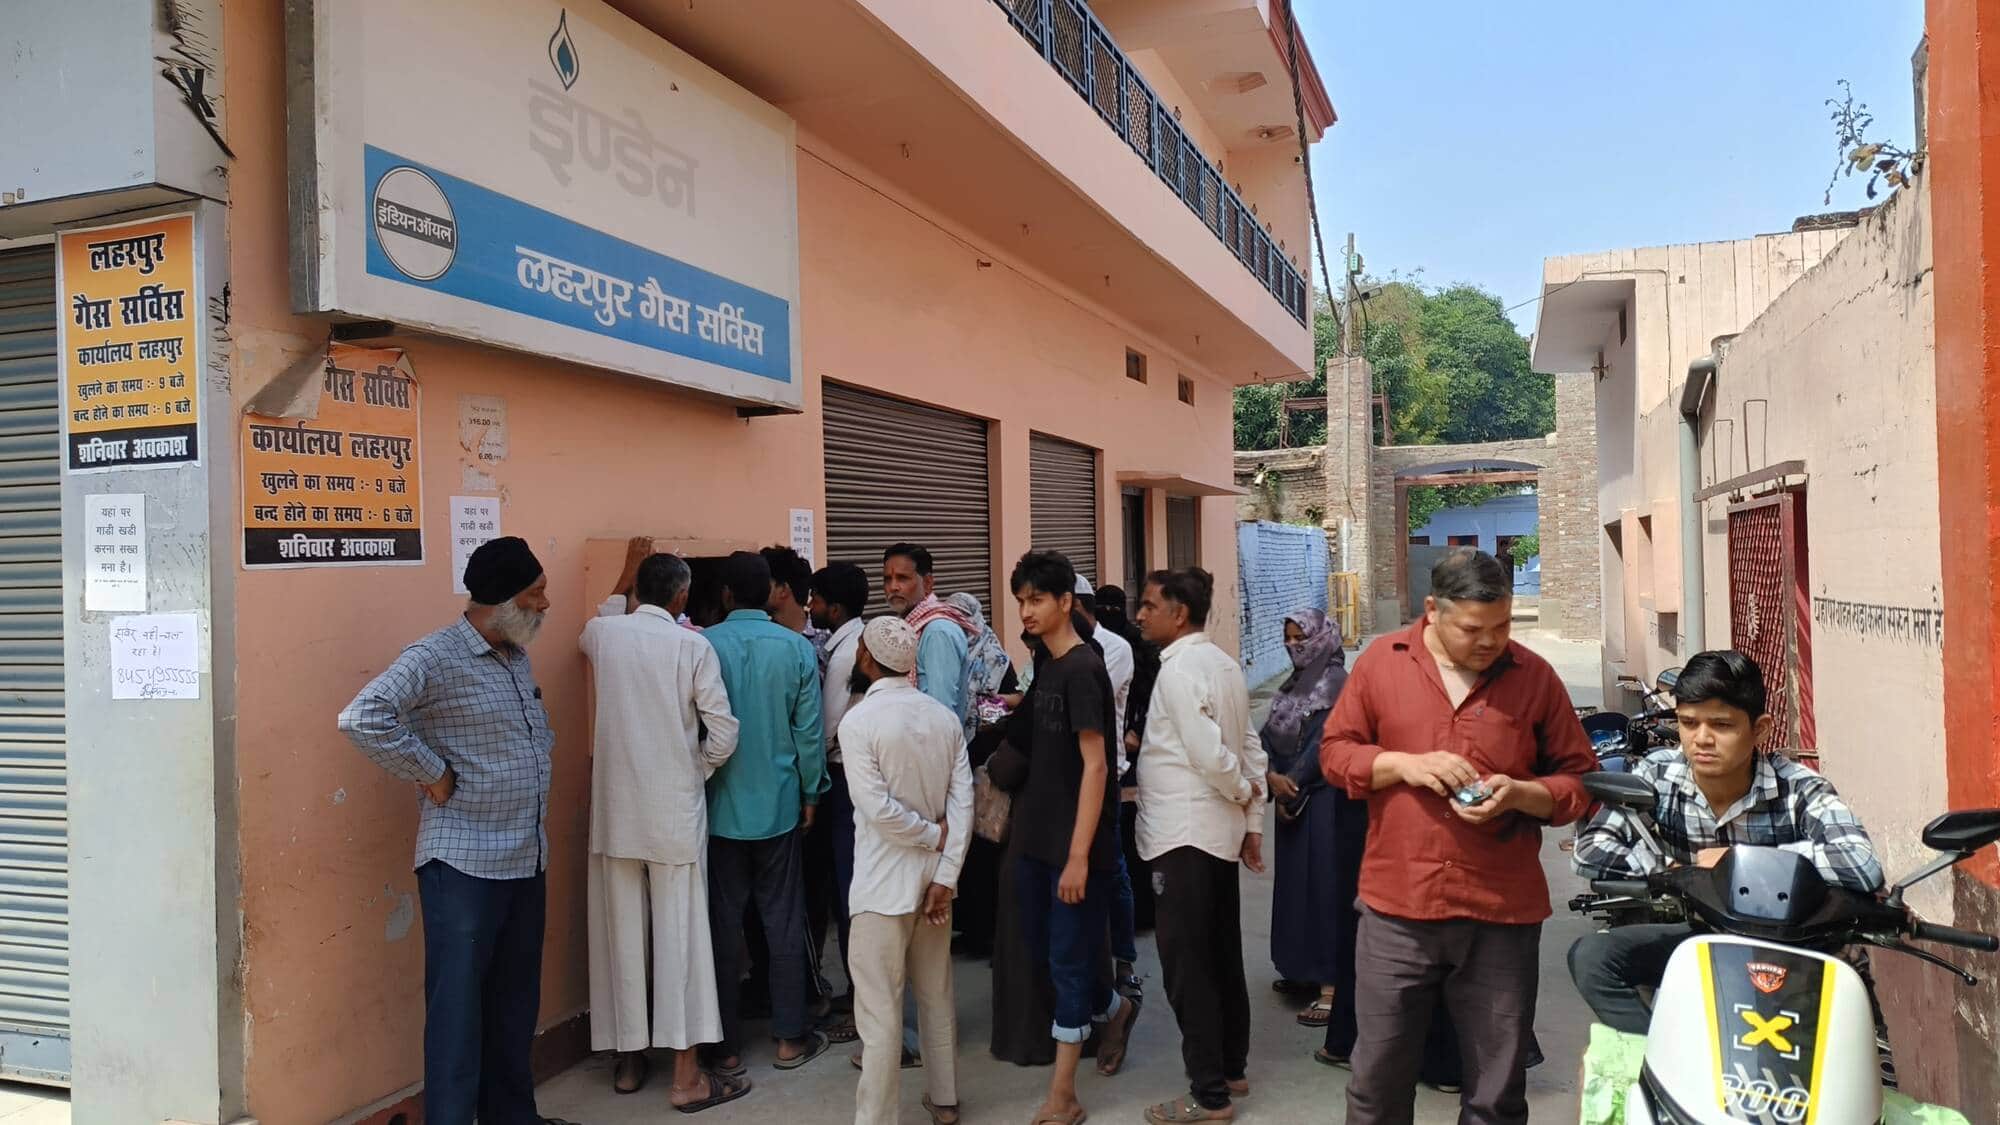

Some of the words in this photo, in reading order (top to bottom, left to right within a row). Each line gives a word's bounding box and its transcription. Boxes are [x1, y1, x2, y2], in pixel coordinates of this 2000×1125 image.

[529, 78, 698, 218] इण्डेन
[378, 203, 453, 243] इंडियनऑयल
[88, 233, 165, 273] लहरपुर
[73, 295, 112, 329] गैस
[120, 284, 184, 324] सर्विस
[515, 245, 633, 326] लहरपुर
[639, 277, 690, 334] गैस
[695, 302, 765, 356] सर्विस
[78, 340, 133, 366] कार्यालय
[138, 338, 183, 363] लहरपुर
[77, 380, 102, 401] खुलने
[106, 381, 118, 394] का
[121, 379, 143, 392] समय
[159, 376, 165, 389] 9
[170, 372, 184, 388] बजे
[362, 366, 410, 408] सर्विस
[73, 409, 89, 422] बन्द
[93, 406, 108, 421] होने
[112, 407, 124, 419] का
[127, 404, 149, 416] समय
[165, 402, 171, 414] 6
[176, 398, 191, 413] बजे
[78, 436, 128, 464] शनिवार
[132, 435, 188, 460] अवकाश
[250, 421, 342, 456] कार्यालय
[349, 433, 412, 468] लहरपुर
[261, 470, 298, 494] खुलने
[303, 475, 321, 490] का
[326, 475, 355, 491] समय
[376, 479, 383, 492] 9
[388, 475, 406, 493] बजे
[121, 508, 131, 517] पर
[254, 505, 278, 521] बन्द
[283, 502, 306, 522] होने
[312, 507, 328, 521] का
[334, 507, 363, 522] समय
[384, 509, 390, 522] 6
[395, 505, 413, 522] बजे
[94, 545, 115, 555] करना
[278, 534, 336, 558] शनिवार
[341, 538, 396, 557] अवकाश
[101, 563, 115, 573] मना
